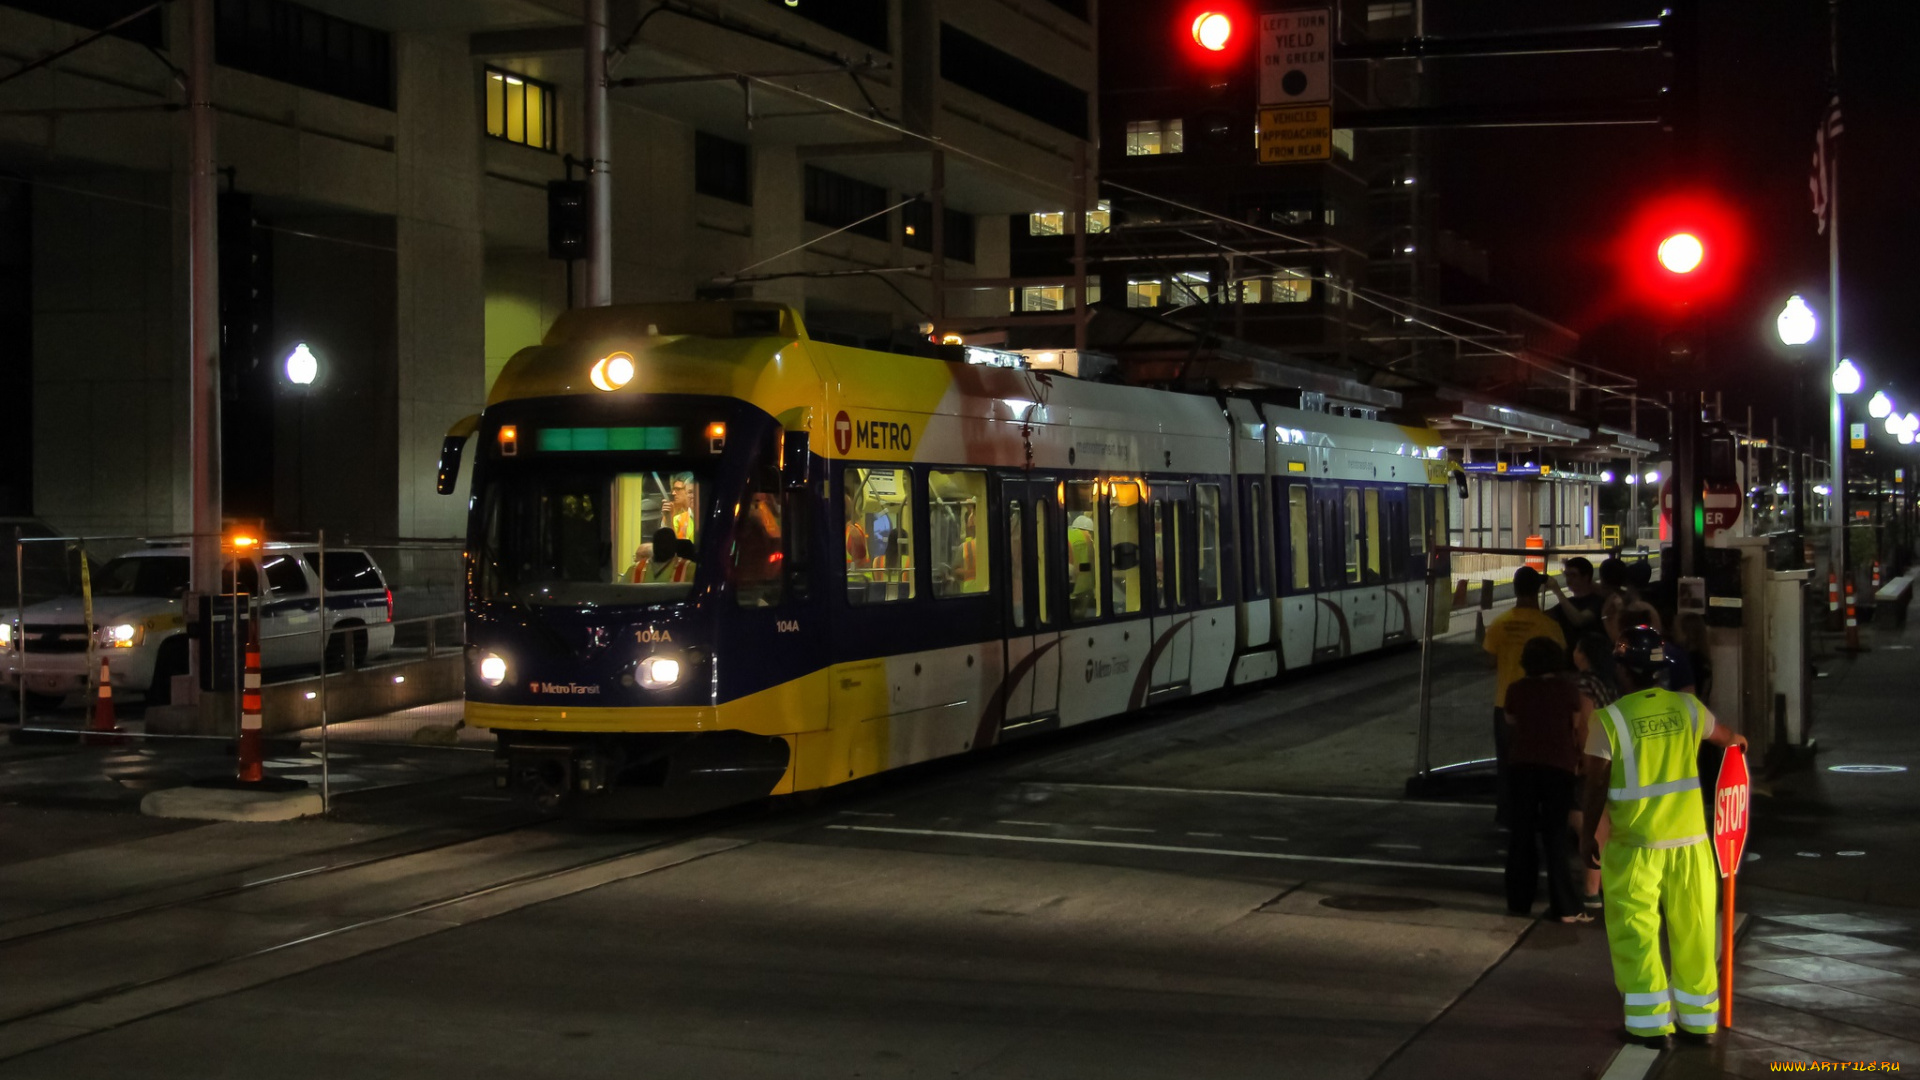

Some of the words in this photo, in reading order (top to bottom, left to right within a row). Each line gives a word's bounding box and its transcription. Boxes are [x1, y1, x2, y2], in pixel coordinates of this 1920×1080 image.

[1263, 18, 1290, 31] LEFT
[1297, 15, 1325, 28] TURN
[1275, 33, 1314, 48] YIELD
[1265, 55, 1280, 66] ON
[1286, 52, 1325, 64] GREEN
[1272, 111, 1318, 124] VEHICLES
[1262, 127, 1328, 141] APPROACHING
[1268, 146, 1294, 158] FROM
[1300, 144, 1322, 156] REAR
[856, 420, 911, 451] METRO
[776, 619, 800, 633] 104A
[634, 629, 672, 643] 104A
[1637, 716, 1678, 734] EGAN
[1717, 784, 1745, 835] STOP
